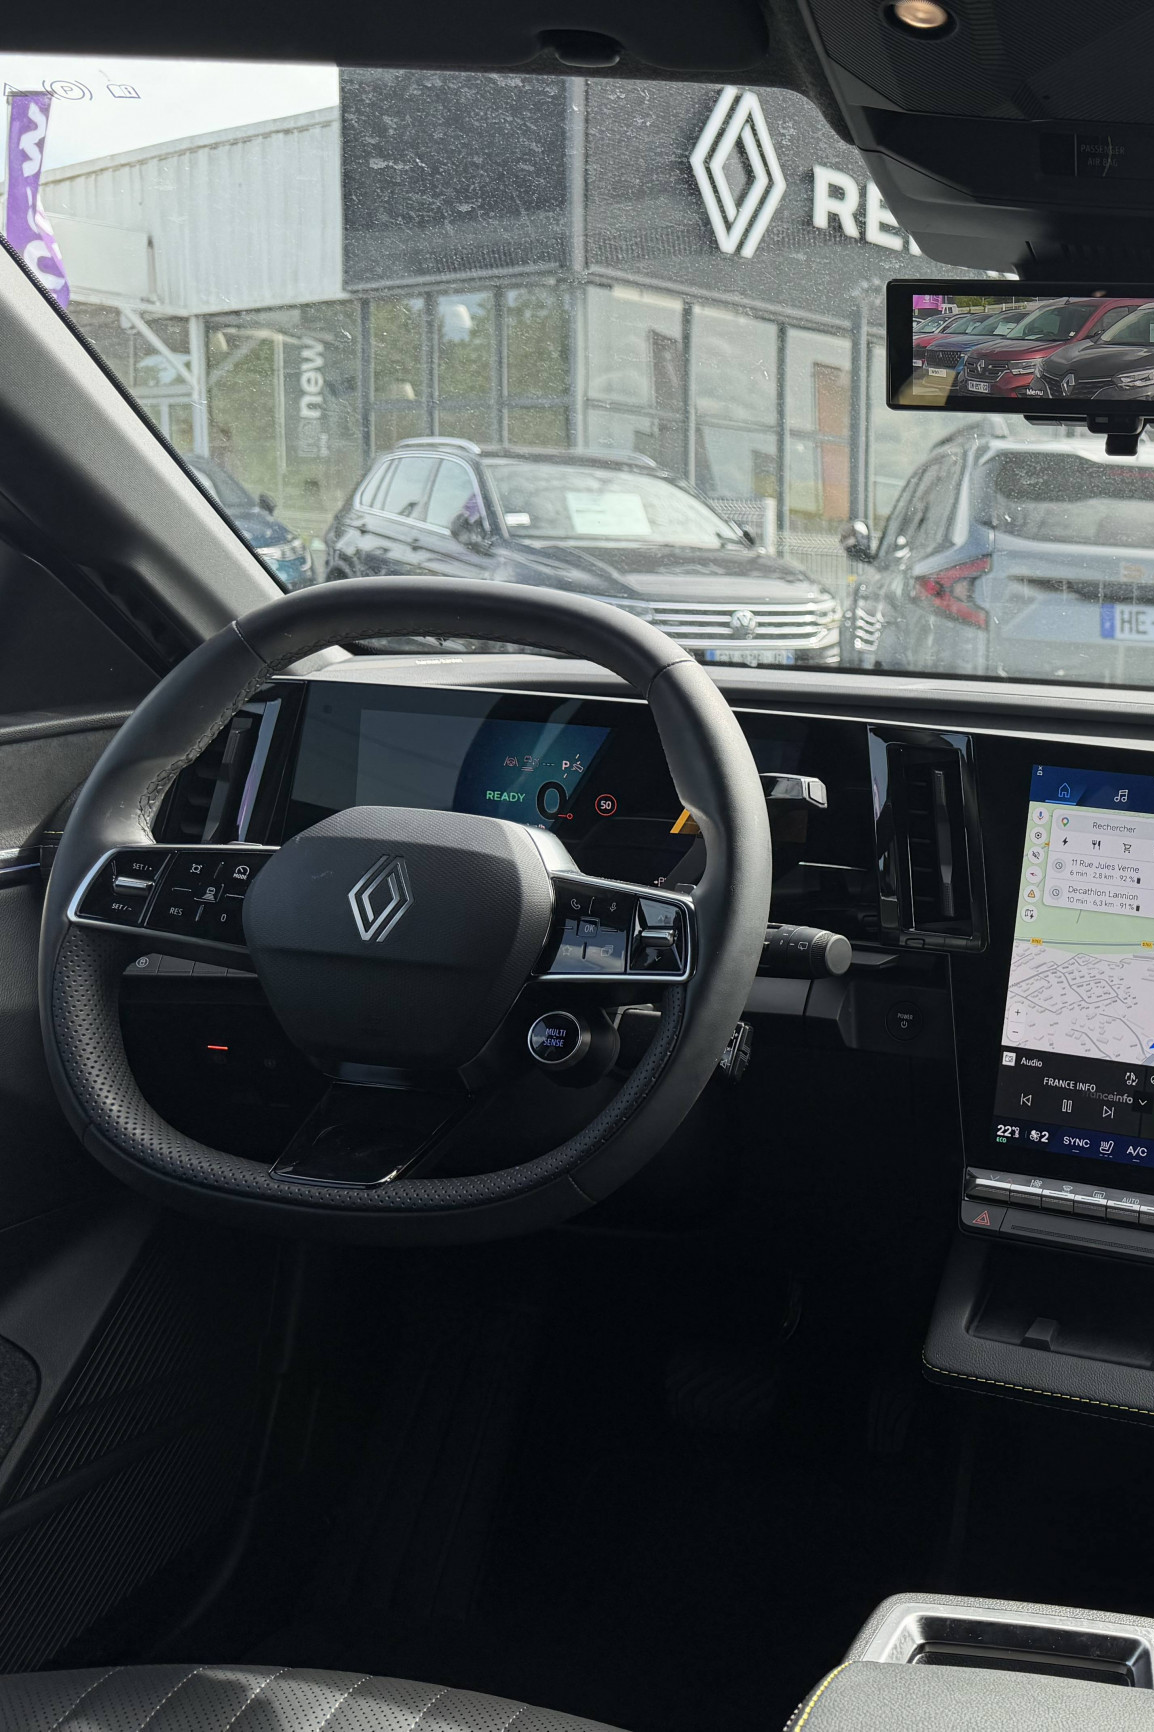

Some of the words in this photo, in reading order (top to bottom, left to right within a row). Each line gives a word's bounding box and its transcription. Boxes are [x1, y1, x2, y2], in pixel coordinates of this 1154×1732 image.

[1080, 144, 1125, 155] PASSENGER
[1087, 157, 1101, 166] AIR
[1103, 158, 1118, 167] BAG
[486, 790, 526, 802] READY
[535, 780, 569, 821] 0
[600, 801, 612, 810] 50
[1092, 821, 1137, 834] Rechercher
[132, 862, 144, 870] SET
[1079, 860, 1094, 869] Rue
[1095, 861, 1116, 871] Jules
[1117, 863, 1140, 874] Verne
[1067, 885, 1107, 897] Decathlon
[1108, 889, 1139, 901] Lannion
[112, 902, 123, 910] SET
[1075, 897, 1088, 905] min
[169, 907, 183, 916] RES
[584, 924, 595, 933] OK
[897, 1012, 914, 1020] POWER
[545, 1028, 567, 1037] MULTI
[543, 1038, 565, 1048] SENSE
[1020, 1057, 1043, 1067] Audio
[1043, 1077, 1075, 1089] FRANCE
[1076, 1082, 1096, 1092] INFO
[1041, 1131, 1049, 1142] 2
[1063, 1136, 1091, 1148] SYNC
[1126, 1146, 1148, 1157] A/C
[1121, 1197, 1140, 1205] AUTO
